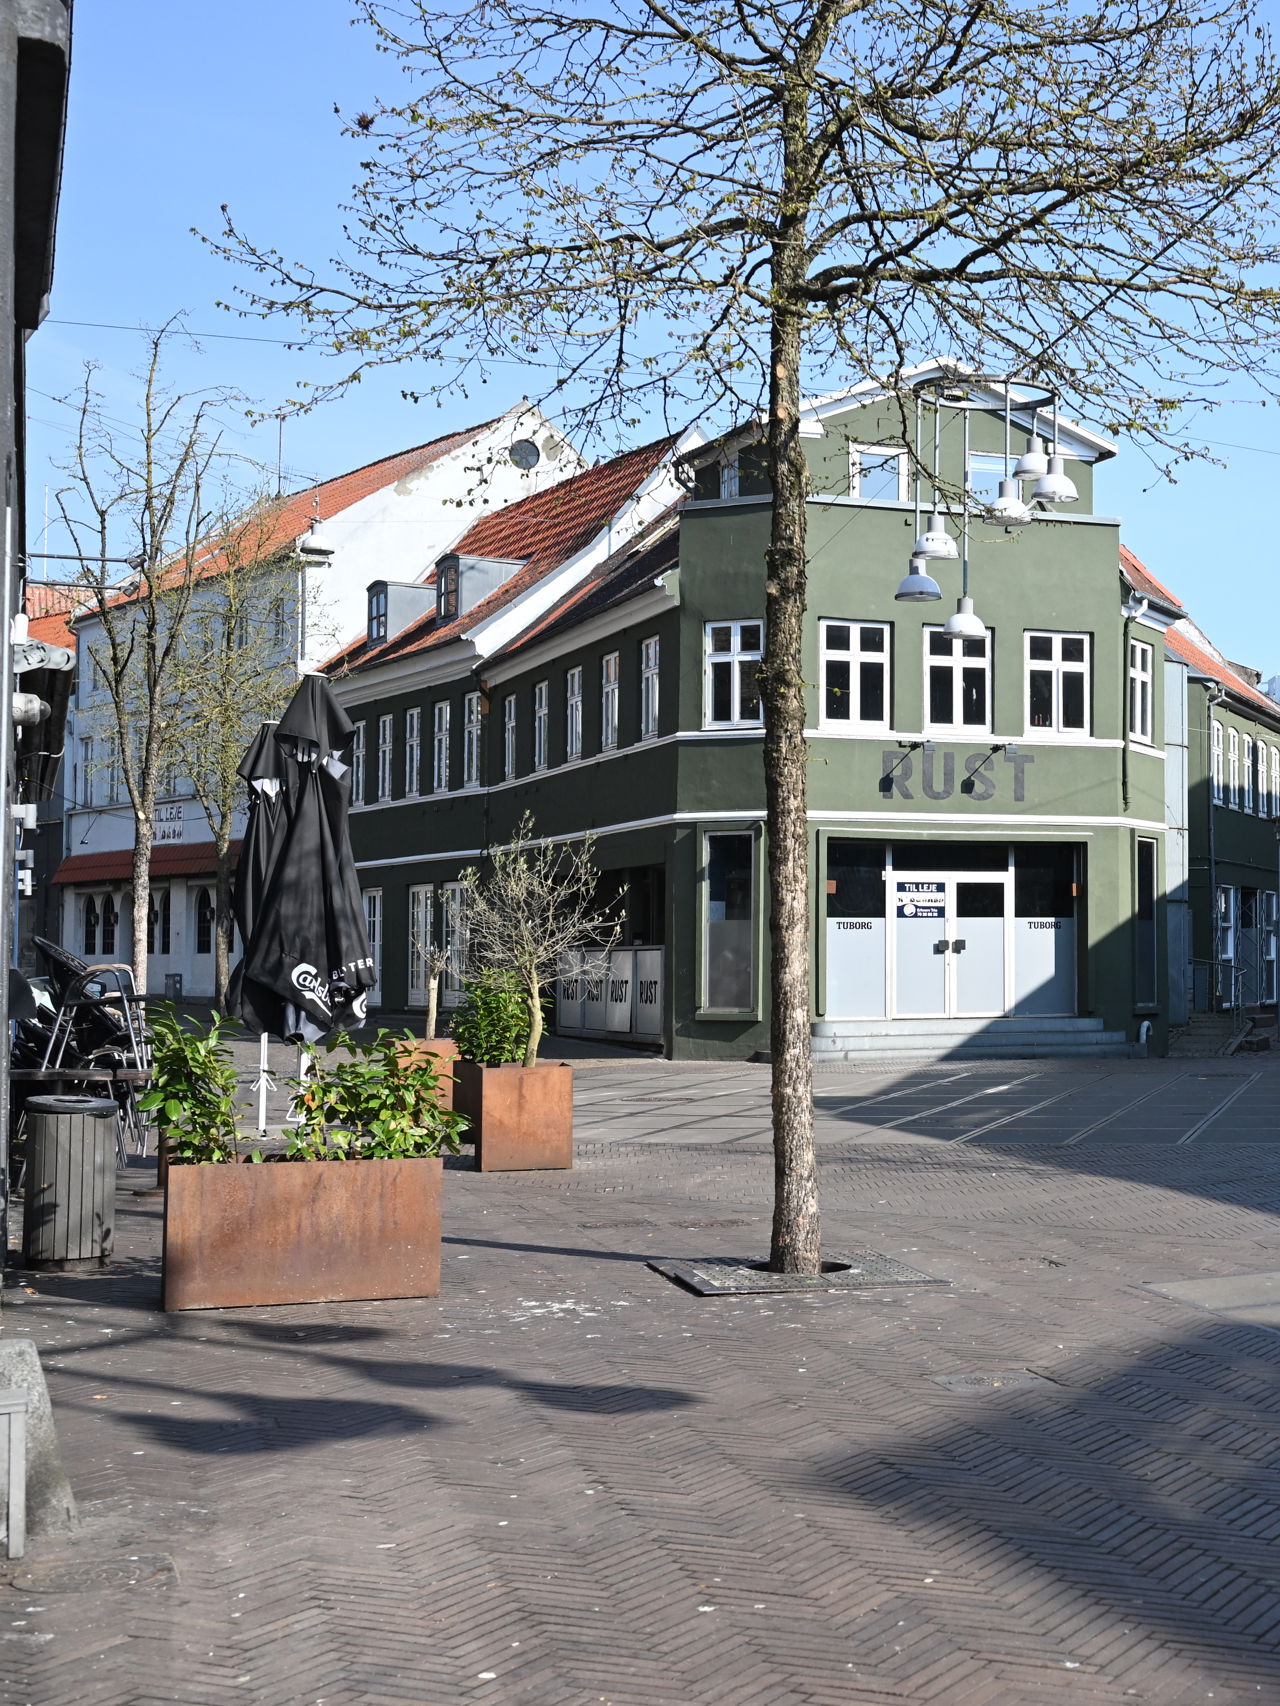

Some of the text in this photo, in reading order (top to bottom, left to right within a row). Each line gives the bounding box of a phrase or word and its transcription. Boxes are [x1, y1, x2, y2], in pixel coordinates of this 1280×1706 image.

[882, 750, 1035, 802] RUST
[904, 883, 938, 892] TIL LEJE
[836, 921, 873, 930] TUBORG
[1027, 921, 1062, 930] TUBORG
[291, 962, 332, 1007] Carlsb
[610, 979, 629, 1003] RUST
[639, 980, 658, 1005] RUST
